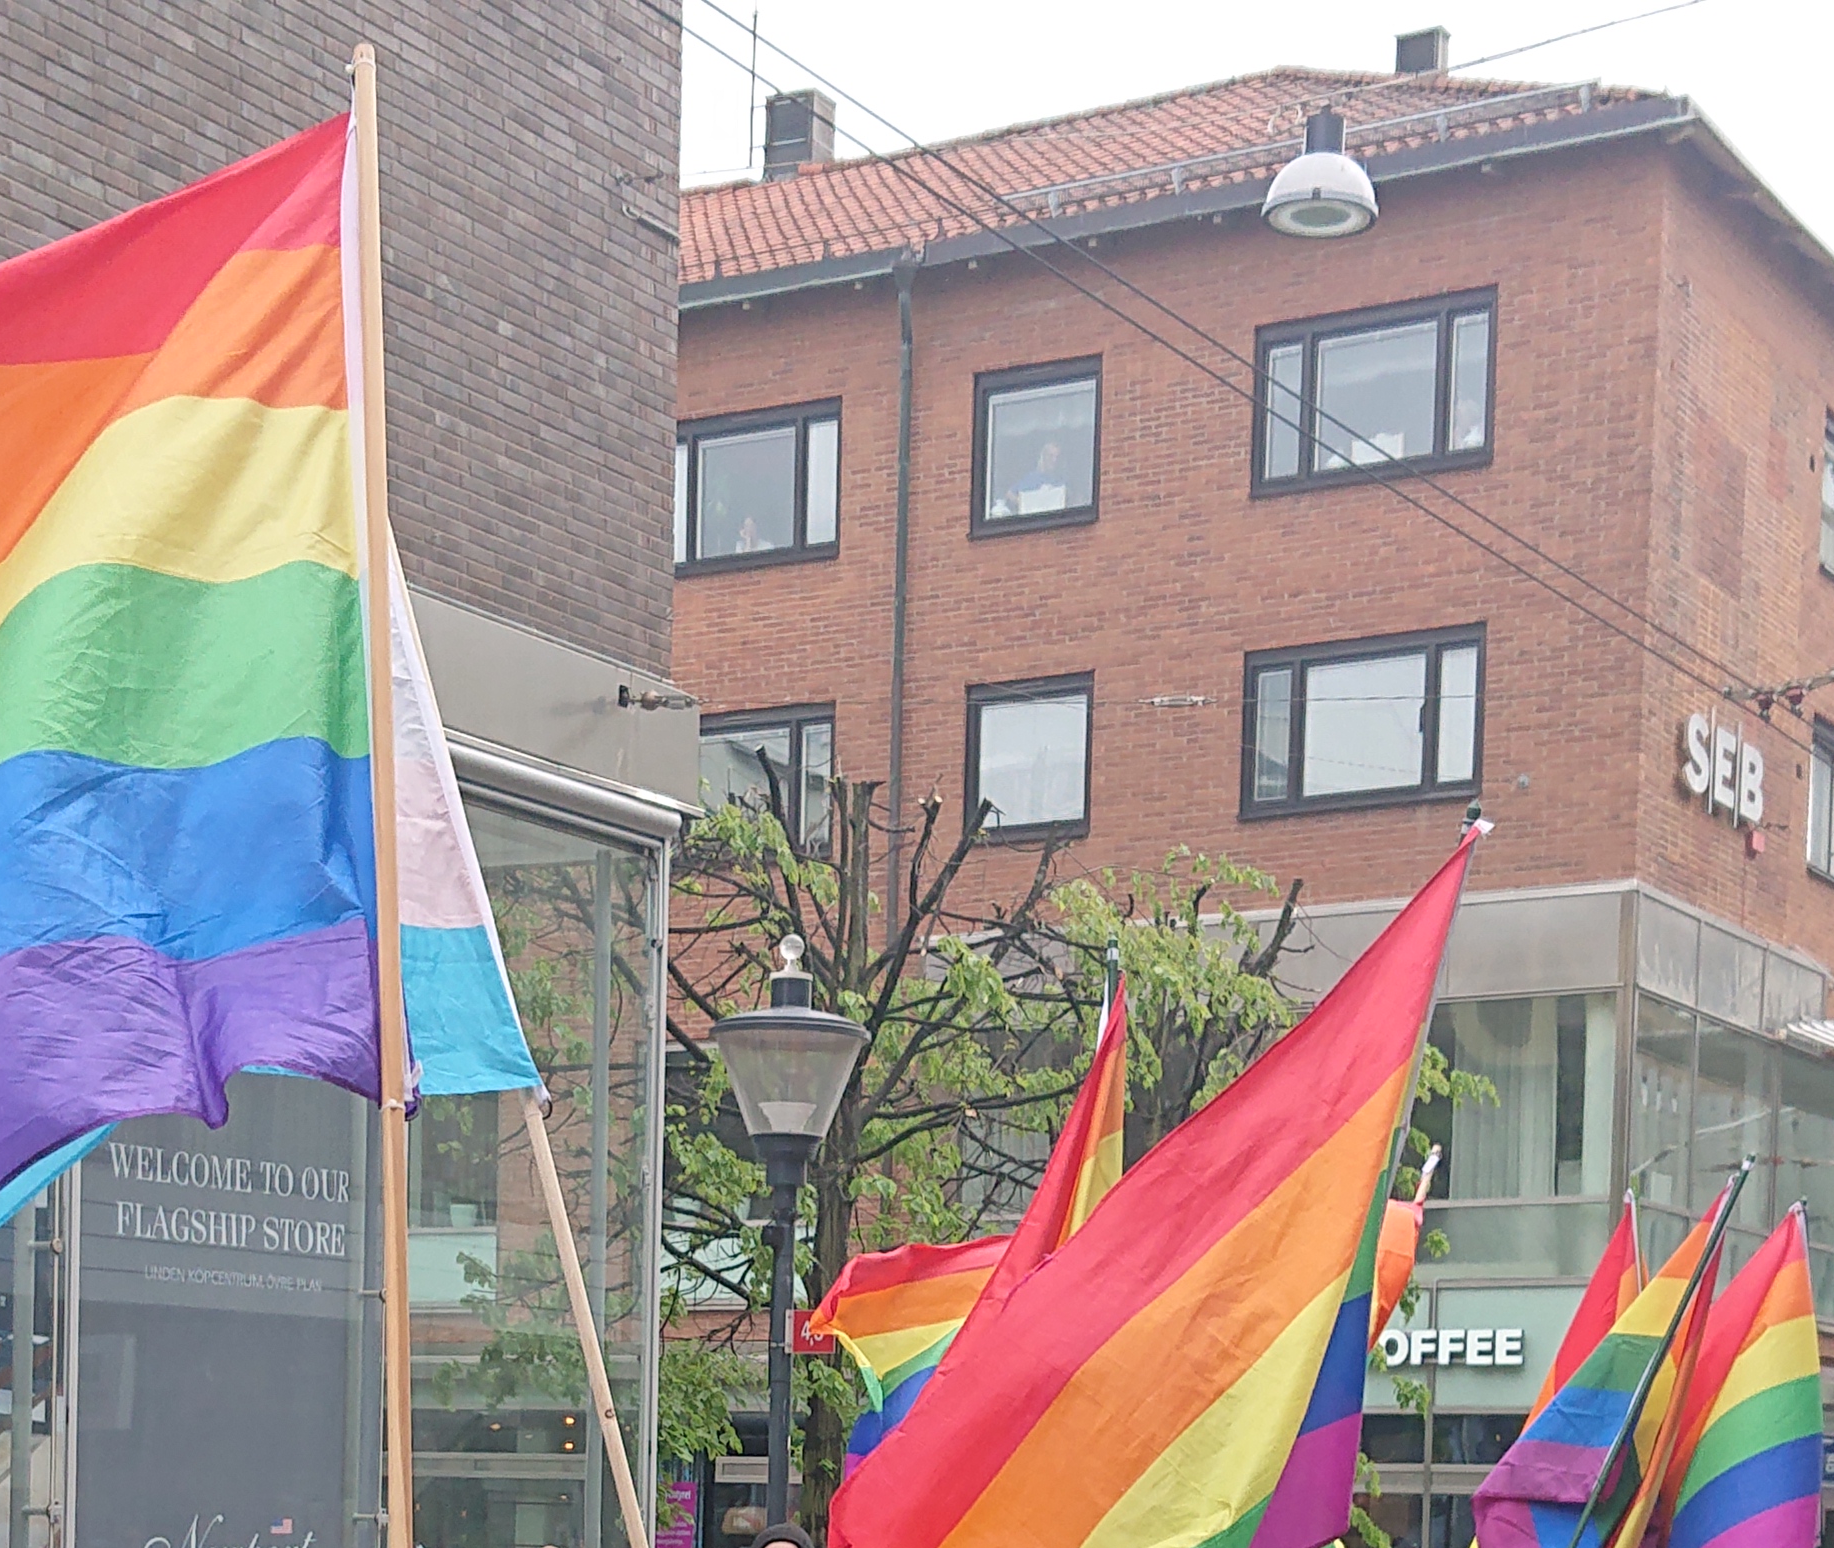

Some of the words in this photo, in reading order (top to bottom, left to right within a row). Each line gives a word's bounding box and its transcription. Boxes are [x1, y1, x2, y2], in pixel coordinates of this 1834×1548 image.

[1682, 713, 1764, 822] SEB
[108, 1142, 253, 1194] WELCOME
[260, 1161, 294, 1197] TO
[301, 1166, 350, 1203] OUR
[116, 1201, 256, 1248] FLAGSHIP
[263, 1216, 346, 1257] STORE
[145, 1264, 185, 1282] LINDEN
[267, 1273, 294, 1291] ÖVRE
[296, 1278, 323, 1293] PLAN
[1378, 1328, 1524, 1366] OFFEE
